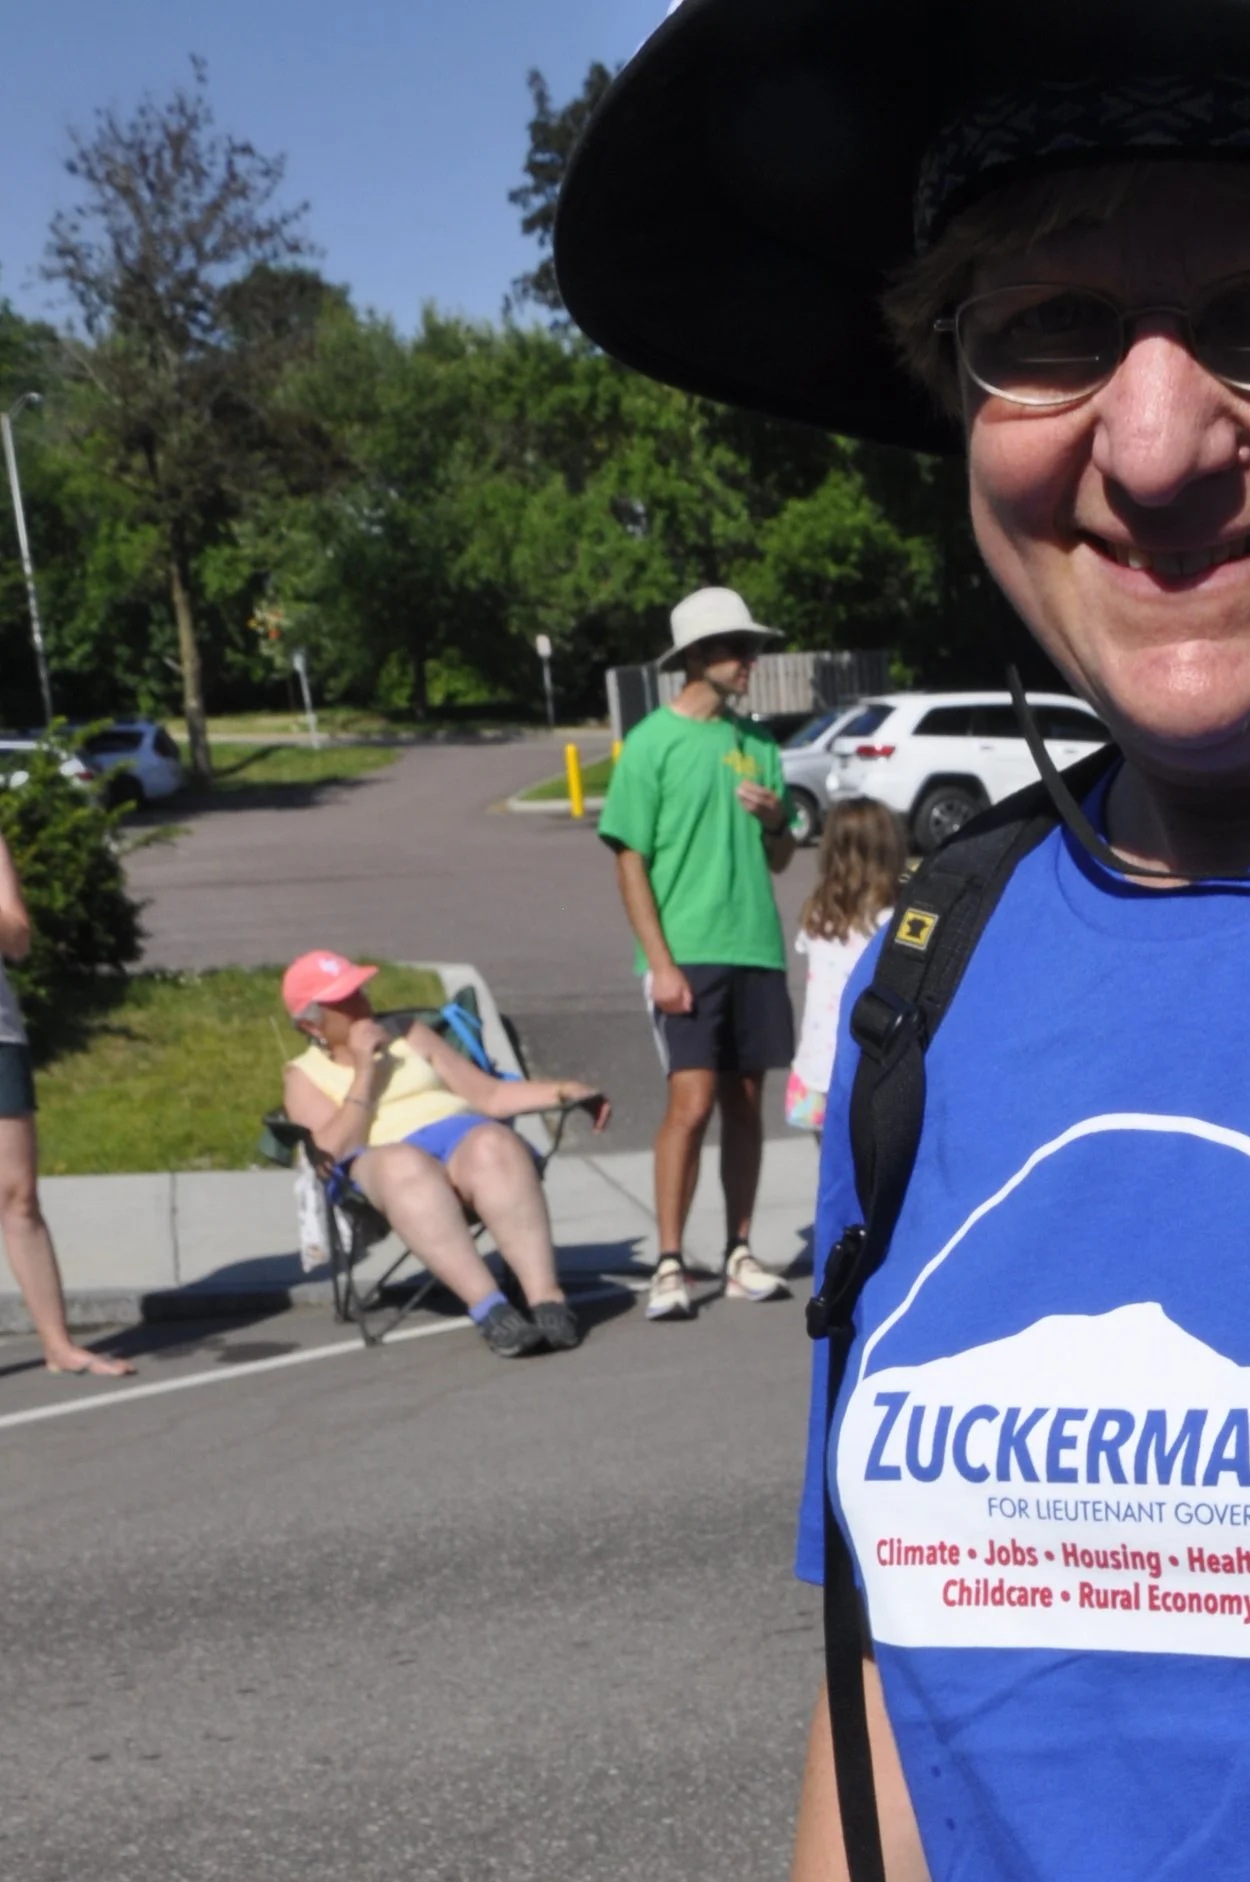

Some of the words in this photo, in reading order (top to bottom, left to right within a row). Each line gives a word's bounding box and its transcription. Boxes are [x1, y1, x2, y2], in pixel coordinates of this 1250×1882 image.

[988, 1497, 1030, 1520] FOR
[1036, 1499, 1167, 1524] LIEUTENANT
[876, 1538, 960, 1567] Climate
[984, 1540, 1038, 1568] Jobs
[1061, 1542, 1161, 1577] Housing
[942, 1579, 1053, 1609] Childcare
[1079, 1581, 1141, 1611] Rural
